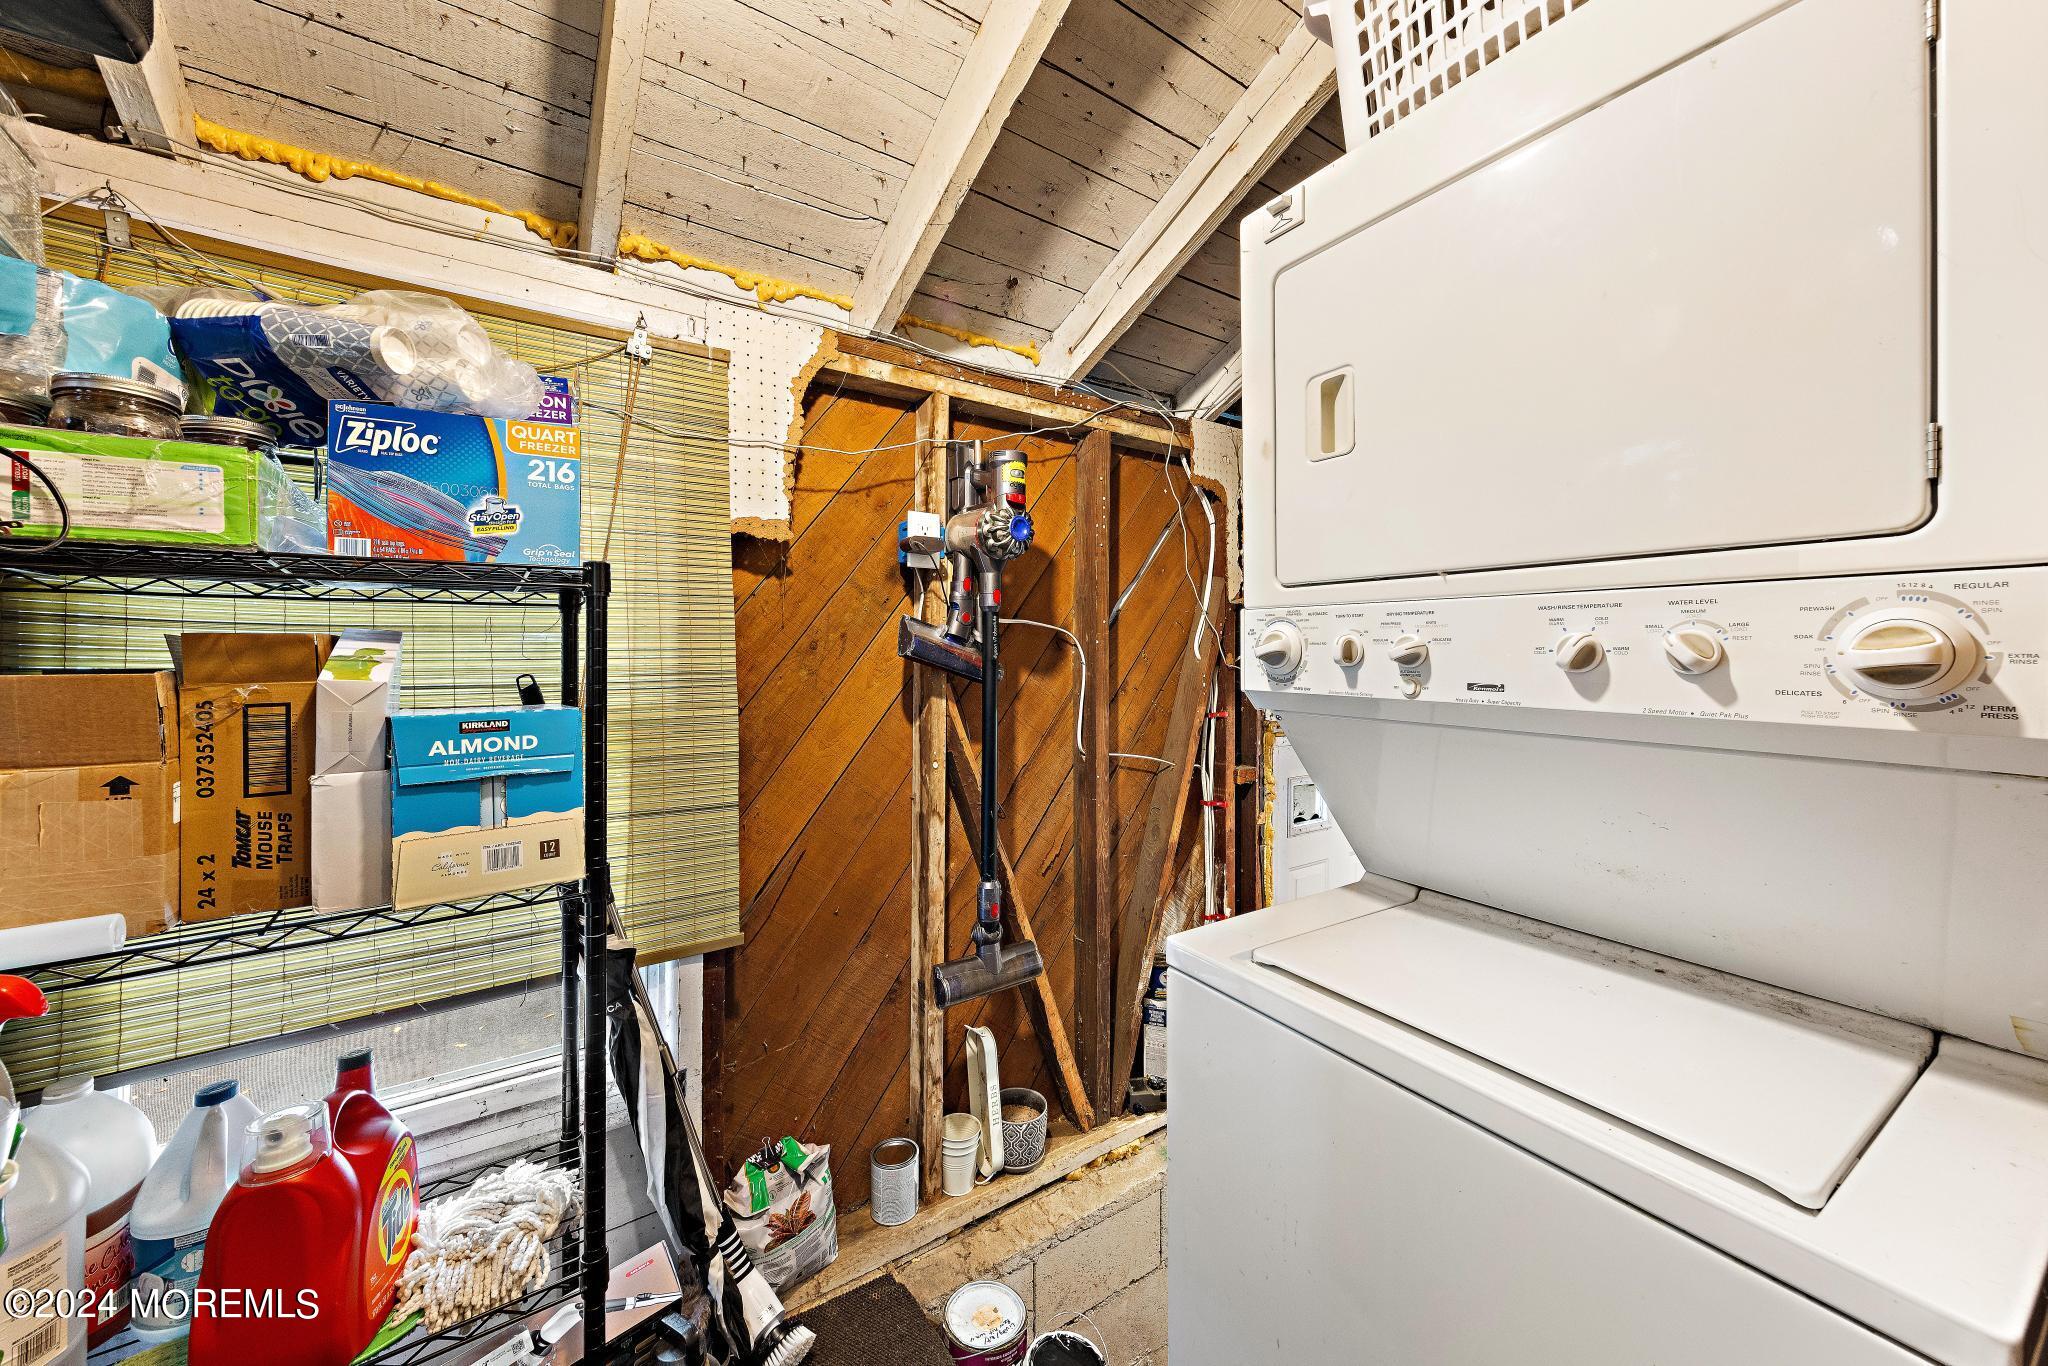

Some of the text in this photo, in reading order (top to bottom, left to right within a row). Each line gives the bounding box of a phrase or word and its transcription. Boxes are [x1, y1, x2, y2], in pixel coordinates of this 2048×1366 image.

[336, 369, 372, 401] VARIETY
[345, 420, 439, 456] Ziploc
[511, 425, 577, 444] QUART
[519, 440, 576, 455] FREEZER
[527, 459, 576, 484] 216
[528, 481, 575, 491] TOTAL BAGS
[491, 524, 515, 532] FILLING
[528, 555, 571, 565] Technology
[553, 550, 575, 558] Seal
[1953, 581, 2010, 590] REGULAR
[1577, 602, 1623, 610] TEMPERATURE
[1473, 684, 1505, 692] Kenmore
[1774, 689, 1823, 697] DELICATES
[1647, 707, 1667, 715] Speed
[1668, 708, 1688, 716] Motor
[1699, 710, 1718, 718] Quiet
[1719, 711, 1732, 719] Pak
[1983, 704, 2017, 713] PERM
[1980, 712, 2019, 720] PRESS
[462, 720, 508, 730] KIRKLAND
[196, 699, 214, 799] 037352405
[428, 735, 538, 757] ALMOND
[444, 753, 524, 766] NON-DAIRY BEVERAGE
[256, 811, 273, 870] MOUSE
[276, 812, 293, 864] TRAPS
[543, 841, 556, 853] 12
[197, 854, 215, 865] 2
[197, 887, 215, 910] 24
[990, 1084, 1000, 1126] HERBS
[381, 1182, 412, 1266] Tide
